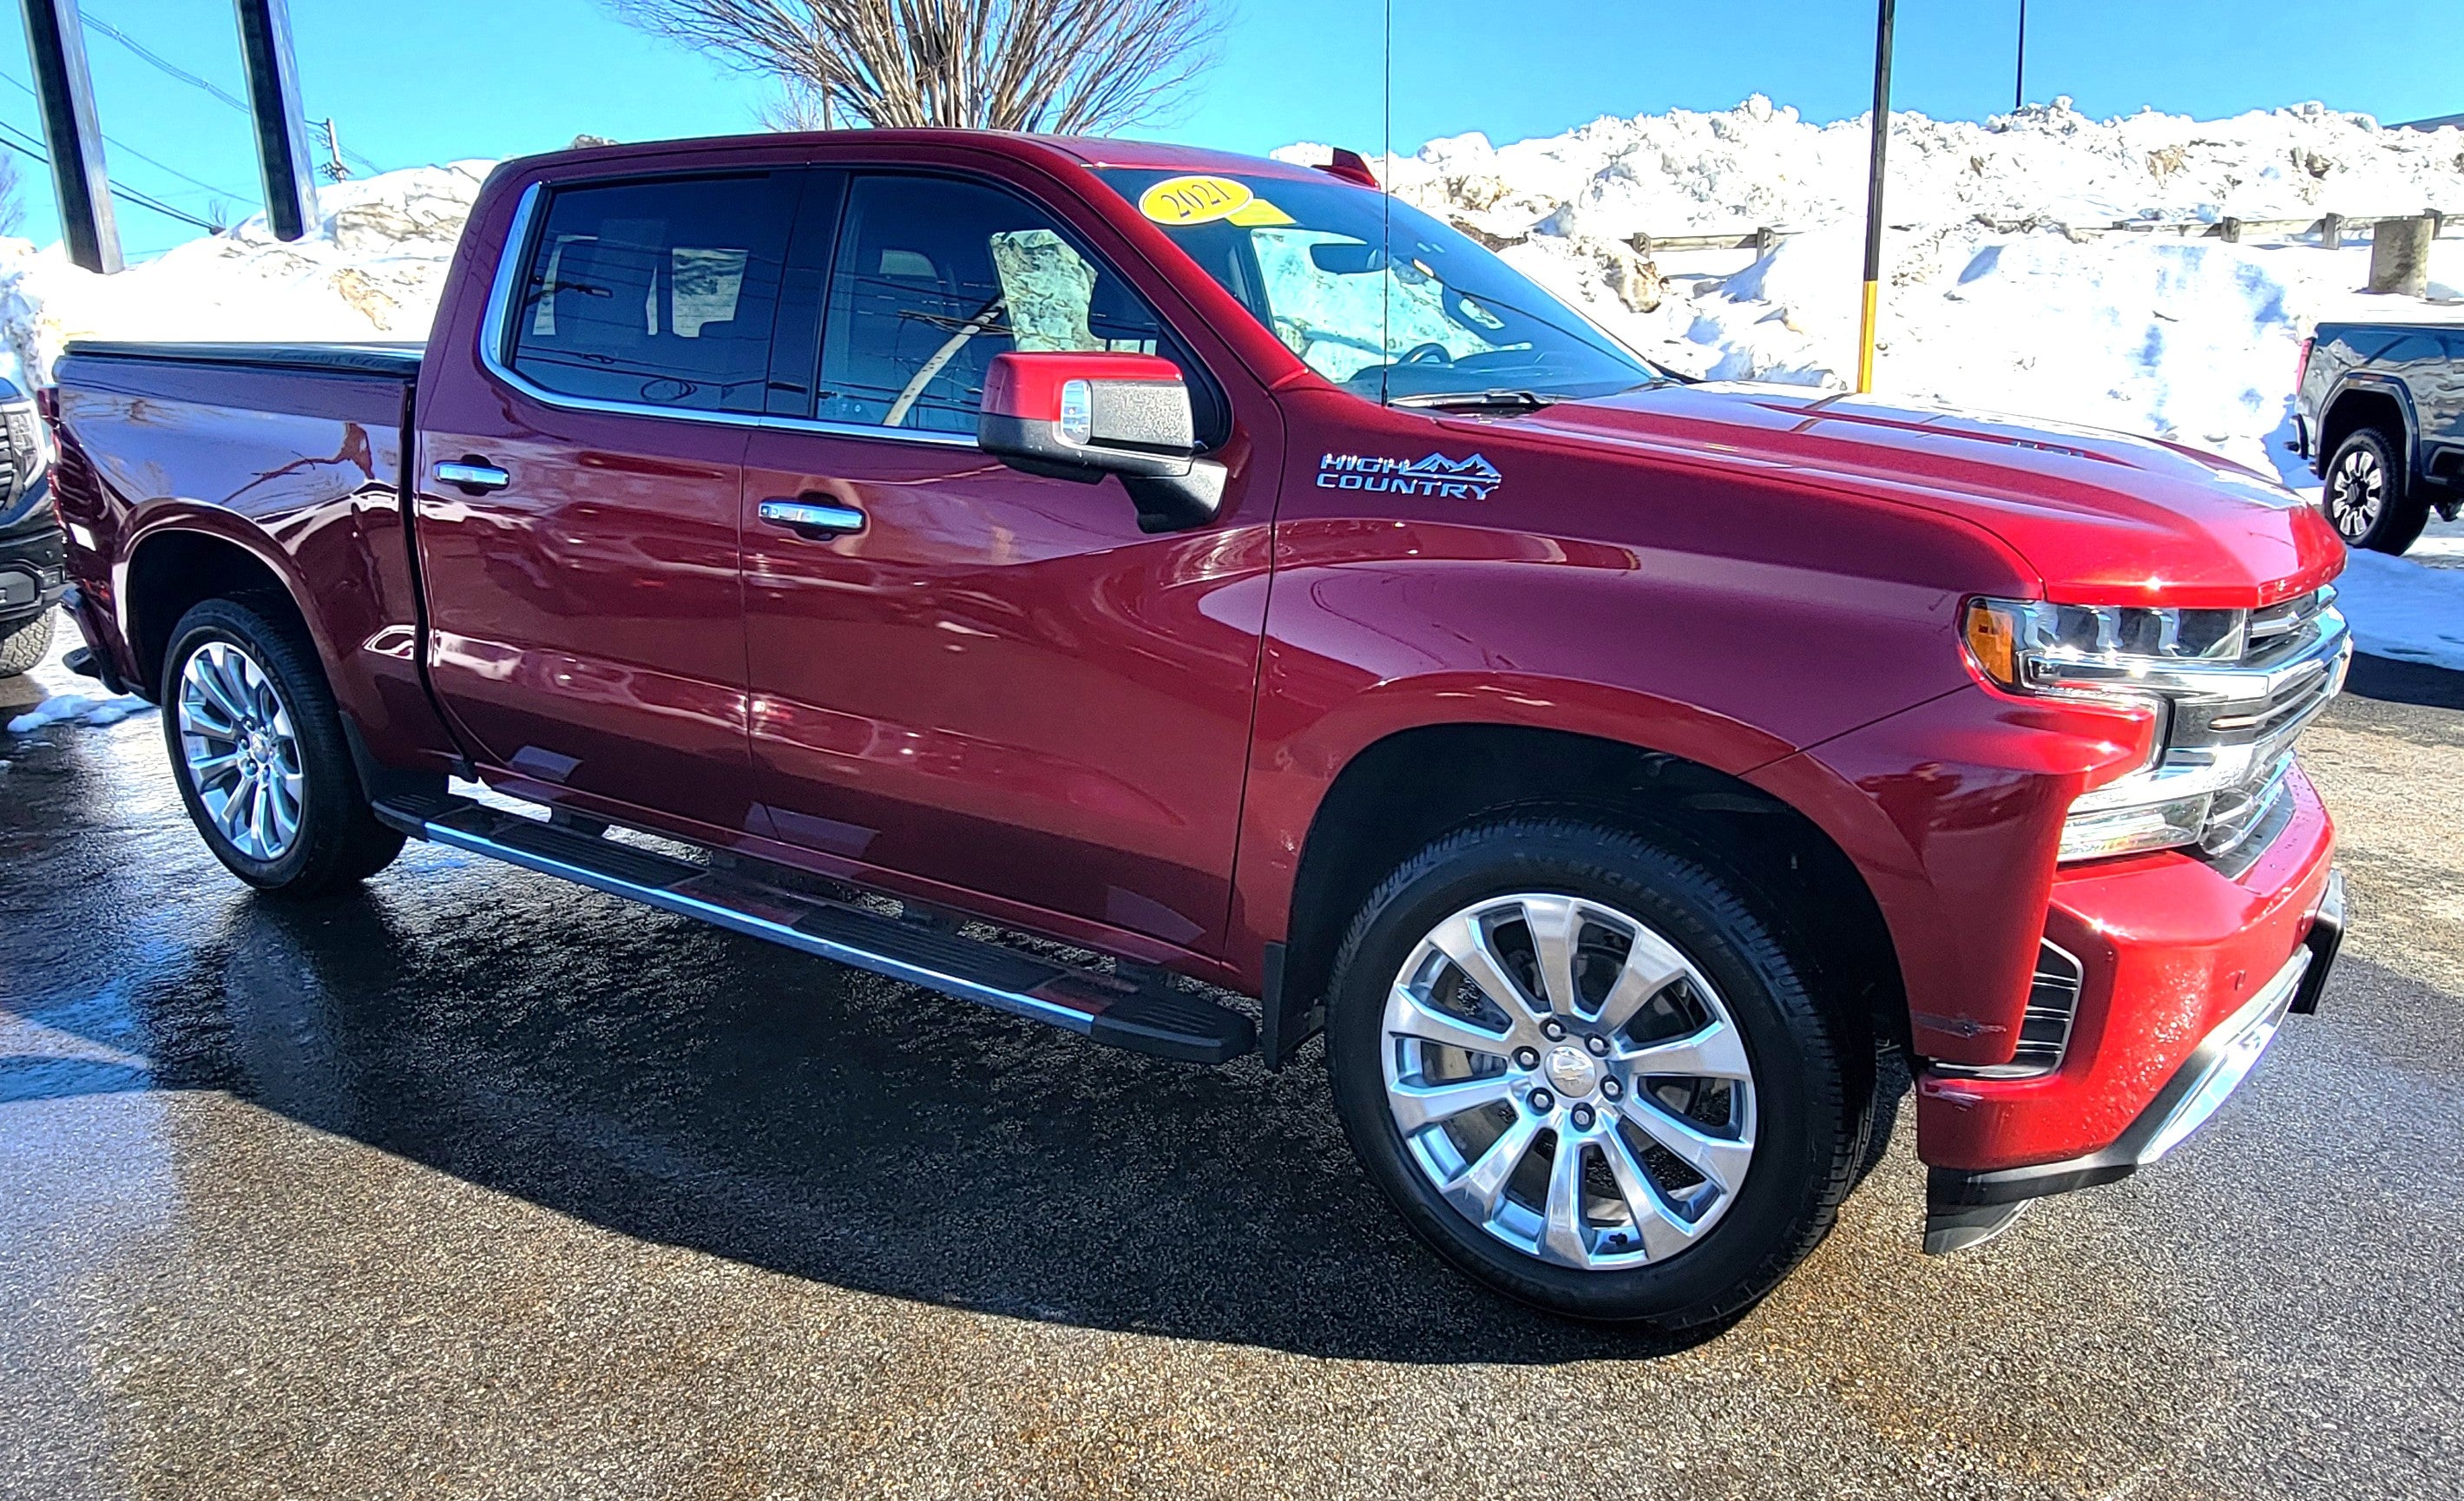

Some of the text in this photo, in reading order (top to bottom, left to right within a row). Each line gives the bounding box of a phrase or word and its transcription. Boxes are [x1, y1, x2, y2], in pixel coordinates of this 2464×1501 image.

[1160, 181, 1232, 217] 2021
[1319, 453, 1411, 474] HIGH
[1317, 473, 1499, 501] COUNTRY
